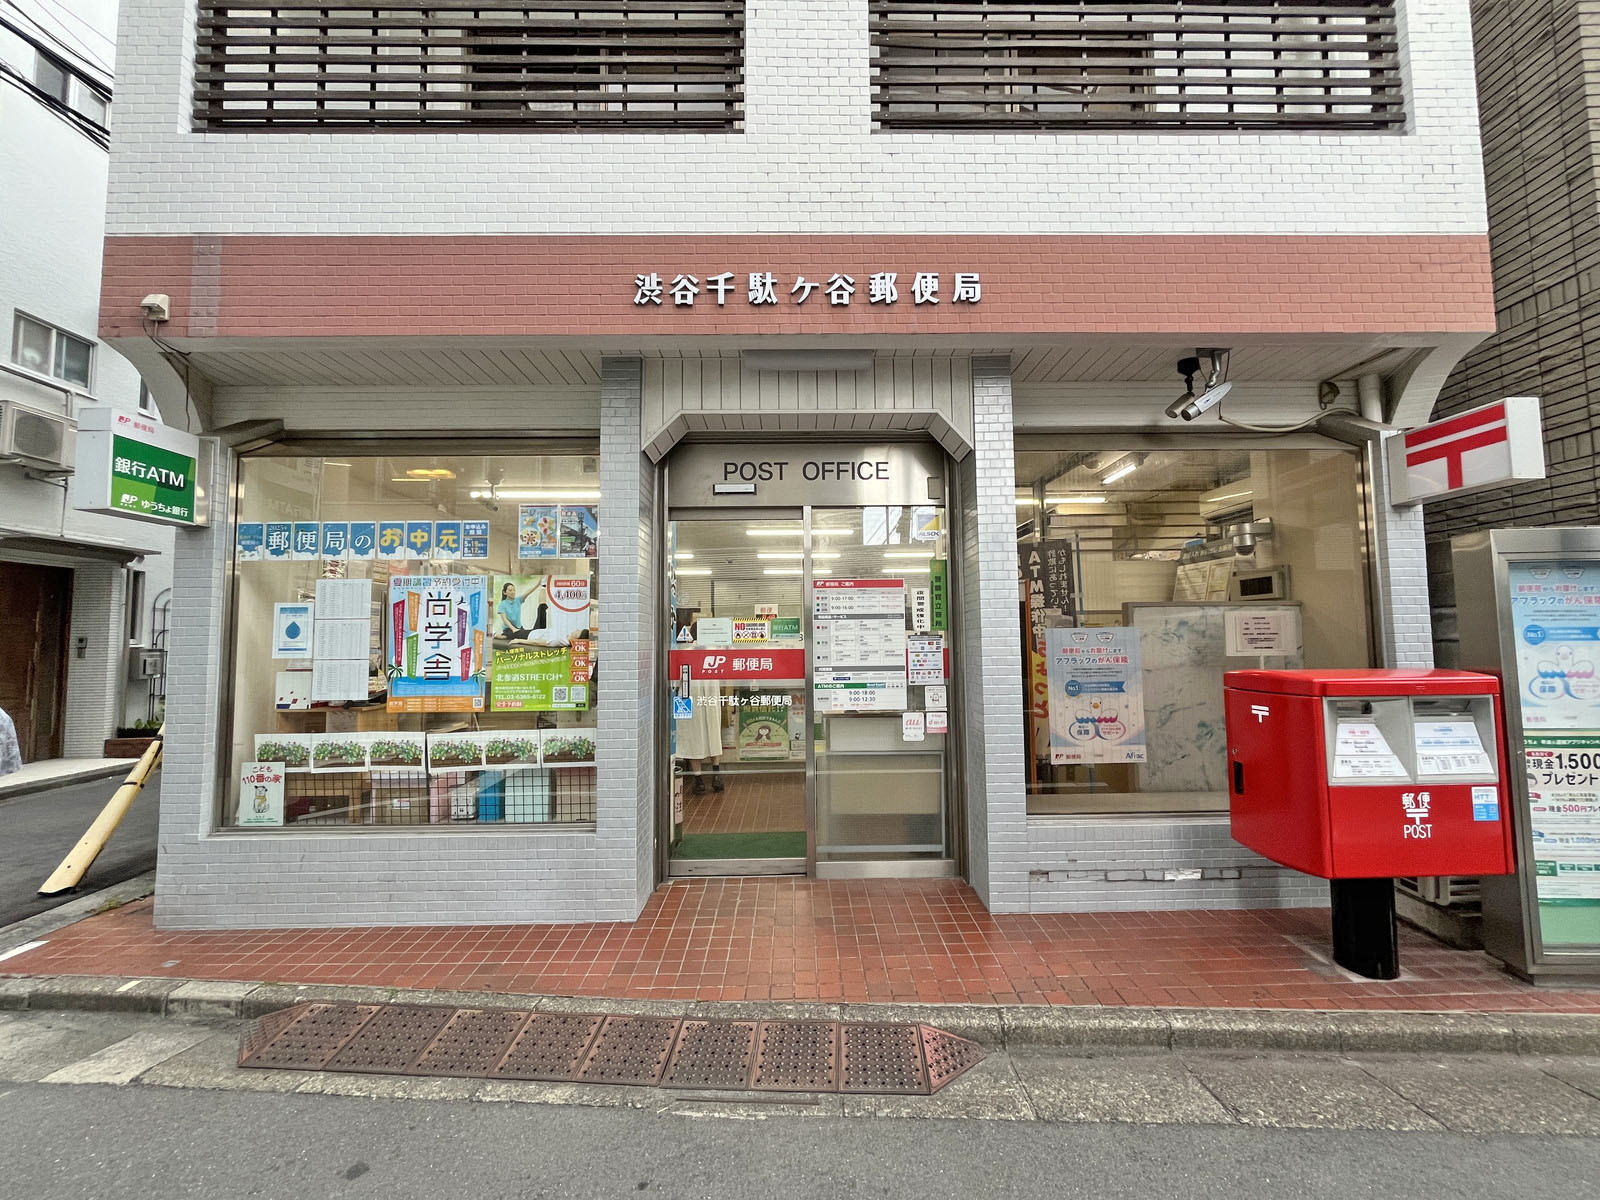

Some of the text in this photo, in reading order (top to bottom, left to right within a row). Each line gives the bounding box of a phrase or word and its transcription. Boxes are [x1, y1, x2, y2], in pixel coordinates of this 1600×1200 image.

[114, 456, 184, 488] 銀行ATM
[723, 461, 890, 481] POST OFFICE
[141, 500, 188, 517] ゆうちょ銀行
[734, 622, 746, 630] NO
[424, 591, 452, 681] 尚学舎
[732, 657, 773, 672] 郵便局
[252, 765, 273, 773] こども
[242, 773, 283, 785] 110番の家
[1542, 771, 1599, 786] プレゼント
[1401, 791, 1432, 809] 郵便
[1403, 824, 1433, 839] POST
